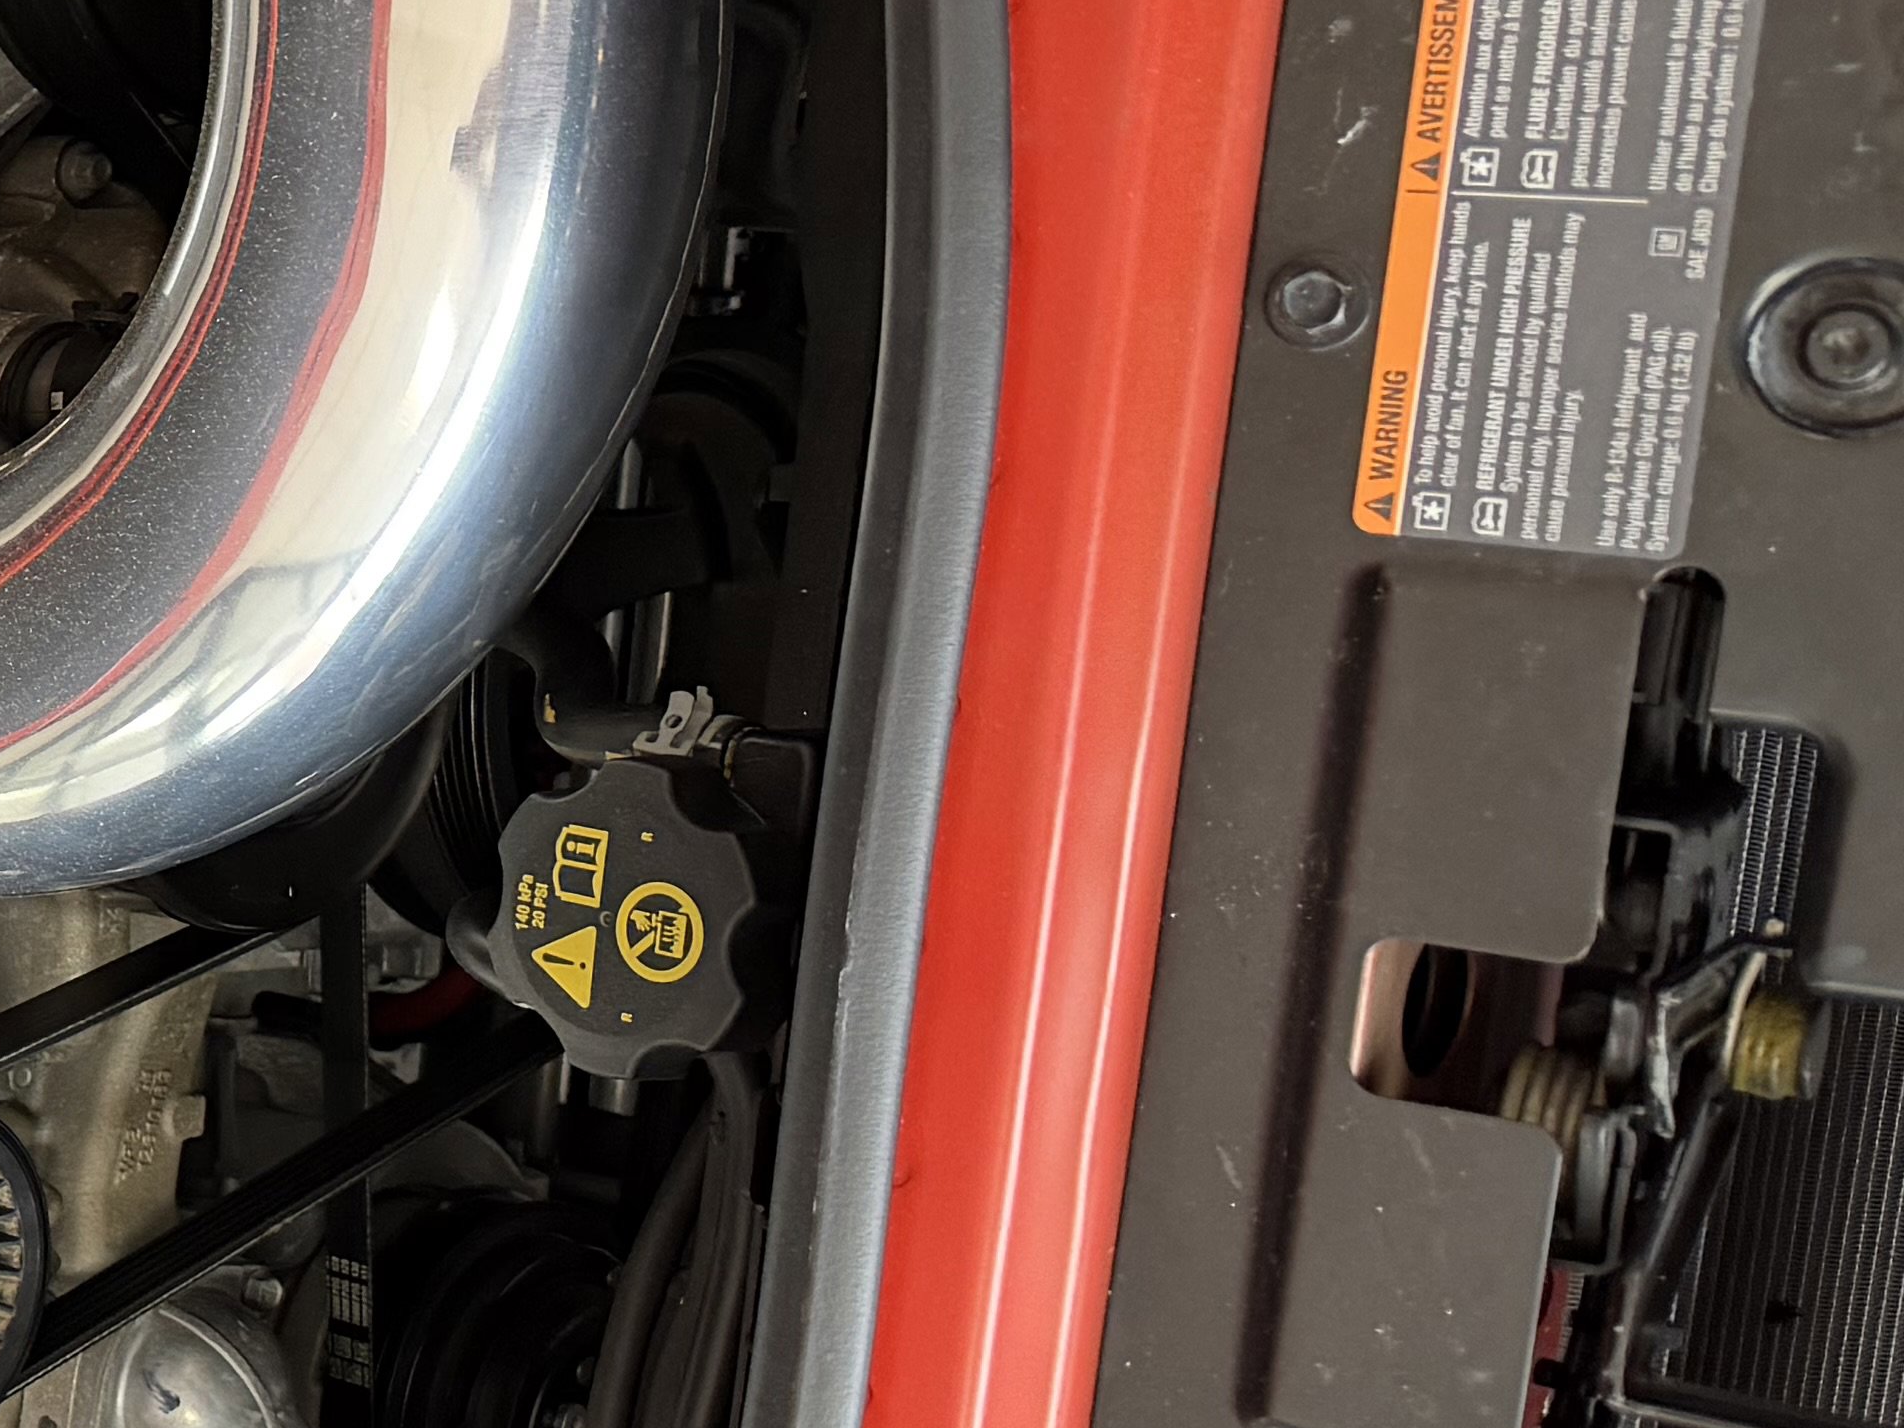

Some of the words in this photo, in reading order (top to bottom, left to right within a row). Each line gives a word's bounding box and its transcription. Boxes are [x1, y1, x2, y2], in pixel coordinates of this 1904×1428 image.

[1500, 21, 1520, 32] à
[1474, 43, 1492, 70] aux
[1497, 34, 1518, 82] mettre
[1562, 38, 1582, 58] du
[1493, 84, 1512, 103] se
[1581, 59, 1604, 113] qualifié
[1462, 72, 1488, 138] Attention
[1489, 104, 1509, 139] peut
[1524, 86, 1550, 140] FLUIDE
[1593, 106, 1621, 188] incorrectes
[1607, 44, 1630, 105] peuvent
[1570, 115, 1595, 188] personnel
[1448, 200, 1471, 245] hands
[1562, 211, 1585, 244] may
[1442, 248, 1466, 283] keep
[1467, 241, 1489, 276] time.
[1503, 217, 1531, 295] PRESSURE
[1685, 249, 1708, 279] SAE
[1466, 279, 1487, 306] any
[1528, 251, 1551, 314] qualified
[1553, 246, 1577, 309] methods
[1462, 307, 1480, 323] at
[1497, 297, 1519, 334] HIGH
[1521, 316, 1545, 335] by
[1628, 312, 1648, 342] and
[1457, 325, 1477, 359] start
[1545, 311, 1567, 364] service
[1430, 330, 1452, 392] personal
[1453, 361, 1472, 388] can
[1490, 336, 1514, 387] UNDER
[1516, 337, 1539, 398] serviced
[1449, 390, 1468, 401] It
[1532, 365, 1560, 431] Improper
[1612, 347, 1642, 428] Refrigerant
[1369, 369, 1408, 481] WARNING
[1424, 393, 1443, 433] avoid
[1444, 404, 1466, 431] fan.
[1509, 400, 1530, 420] be
[1443, 433, 1462, 449] of
[1475, 389, 1505, 491] REFRIGERANT
[1507, 423, 1527, 437] to
[1417, 435, 1440, 466] help
[1498, 439, 1524, 493] System
[1551, 434, 1574, 498] personal
[1604, 430, 1630, 483] R-134a
[1412, 467, 1433, 484] To
[1438, 450, 1459, 487] clear
[1520, 469, 1544, 540] personnel
[1601, 485, 1626, 517] only
[1544, 499, 1565, 542] cause
[1595, 518, 1618, 547] Use
[517, 873, 535, 904] kPa
[532, 883, 549, 905] PSI
[513, 907, 529, 930] 140
[530, 906, 545, 928] 20
